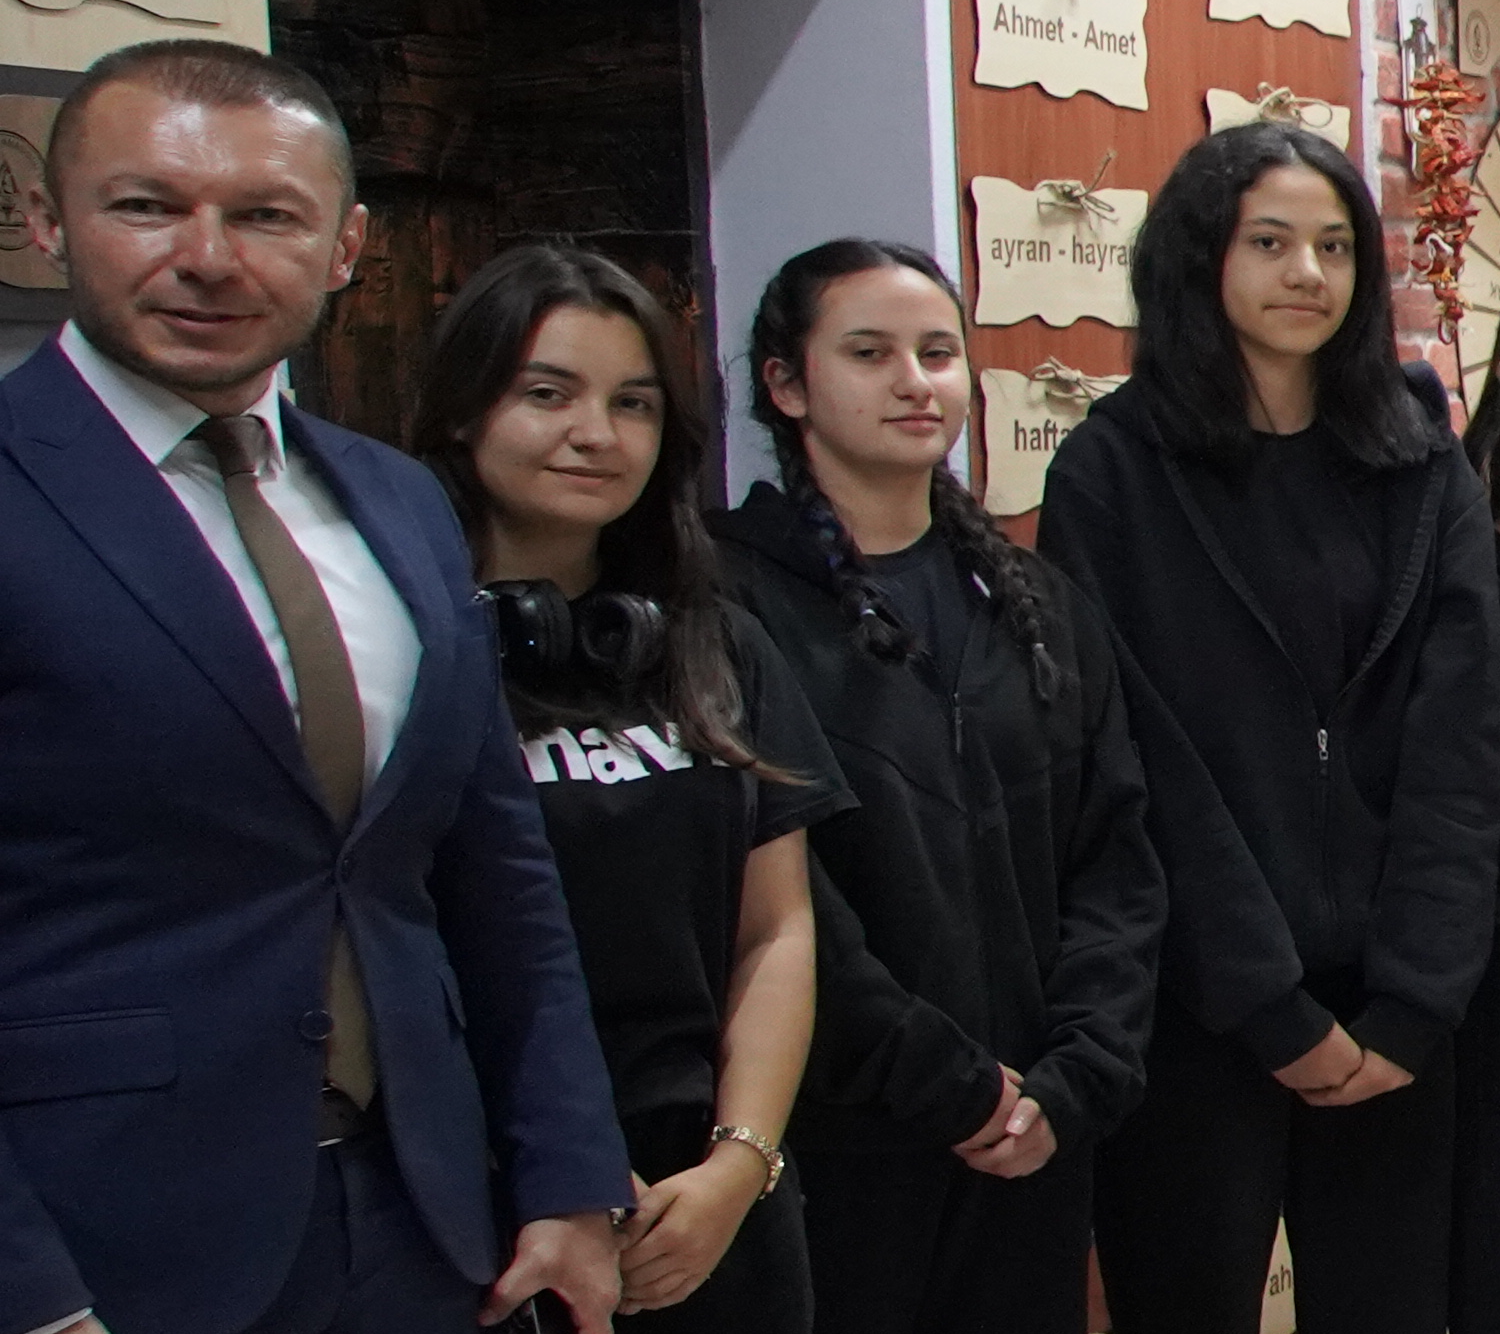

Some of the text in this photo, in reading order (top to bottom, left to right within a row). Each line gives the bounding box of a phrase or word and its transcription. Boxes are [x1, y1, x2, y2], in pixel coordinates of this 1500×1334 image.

[993, 2, 1138, 58] Ahmet Amet
[990, 235, 1133, 272] ayran hayra
